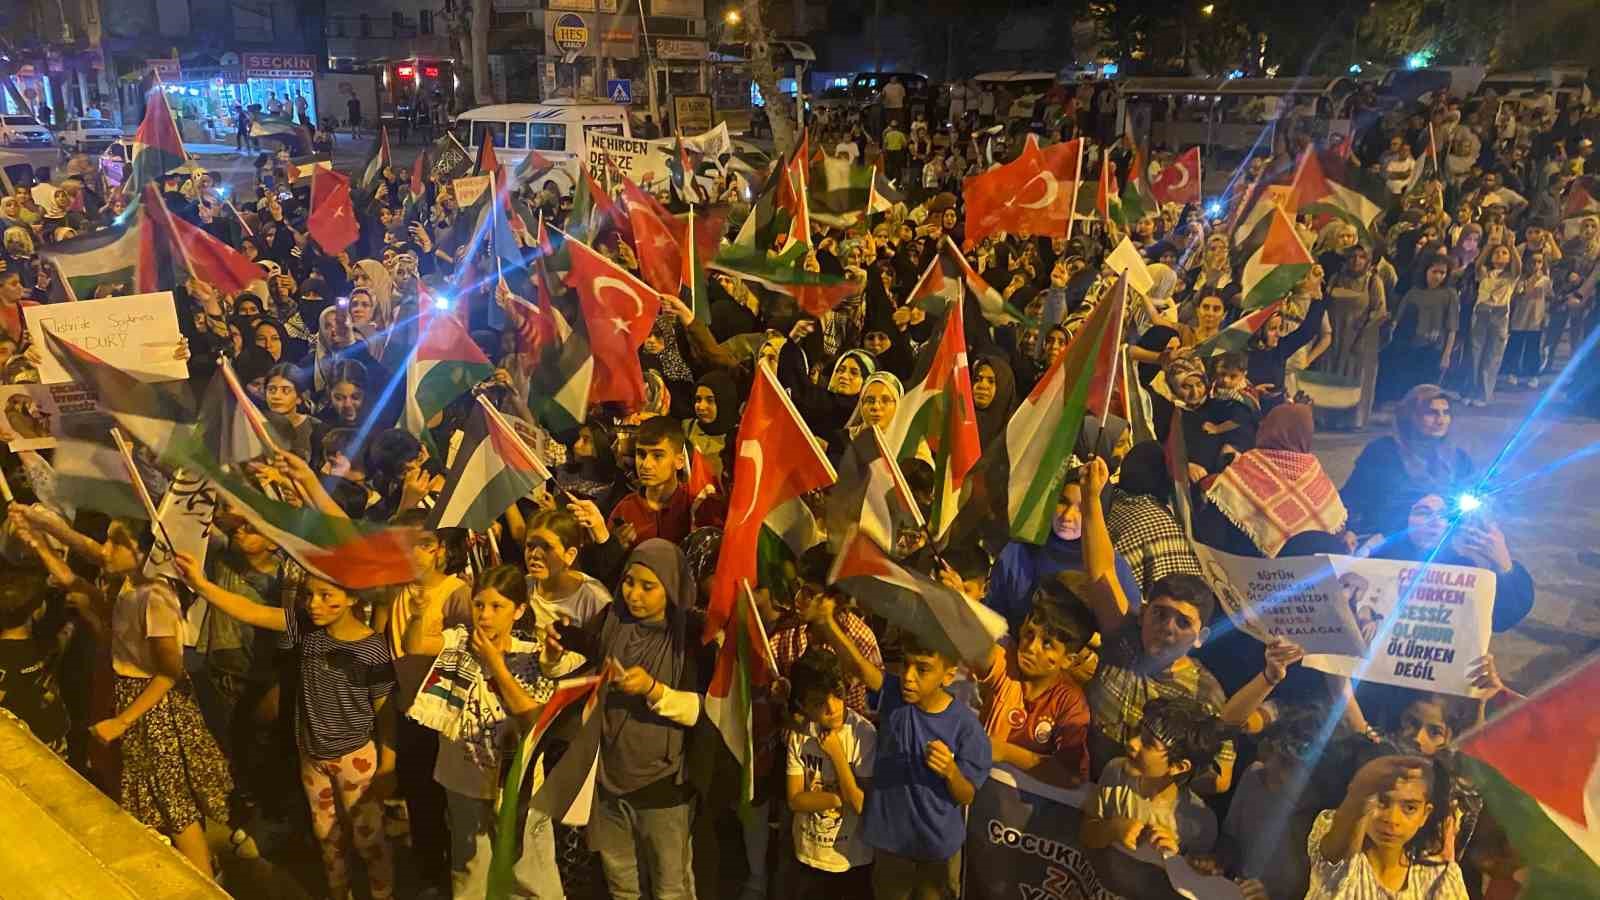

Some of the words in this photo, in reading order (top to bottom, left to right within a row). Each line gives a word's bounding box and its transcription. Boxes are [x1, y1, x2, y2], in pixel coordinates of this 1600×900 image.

[560, 29, 583, 40] HES
[1398, 567, 1476, 588] ÇOUKLAR
[1387, 638, 1455, 664] ÖLÜRKEN
[1394, 660, 1435, 680] DEĞİL
